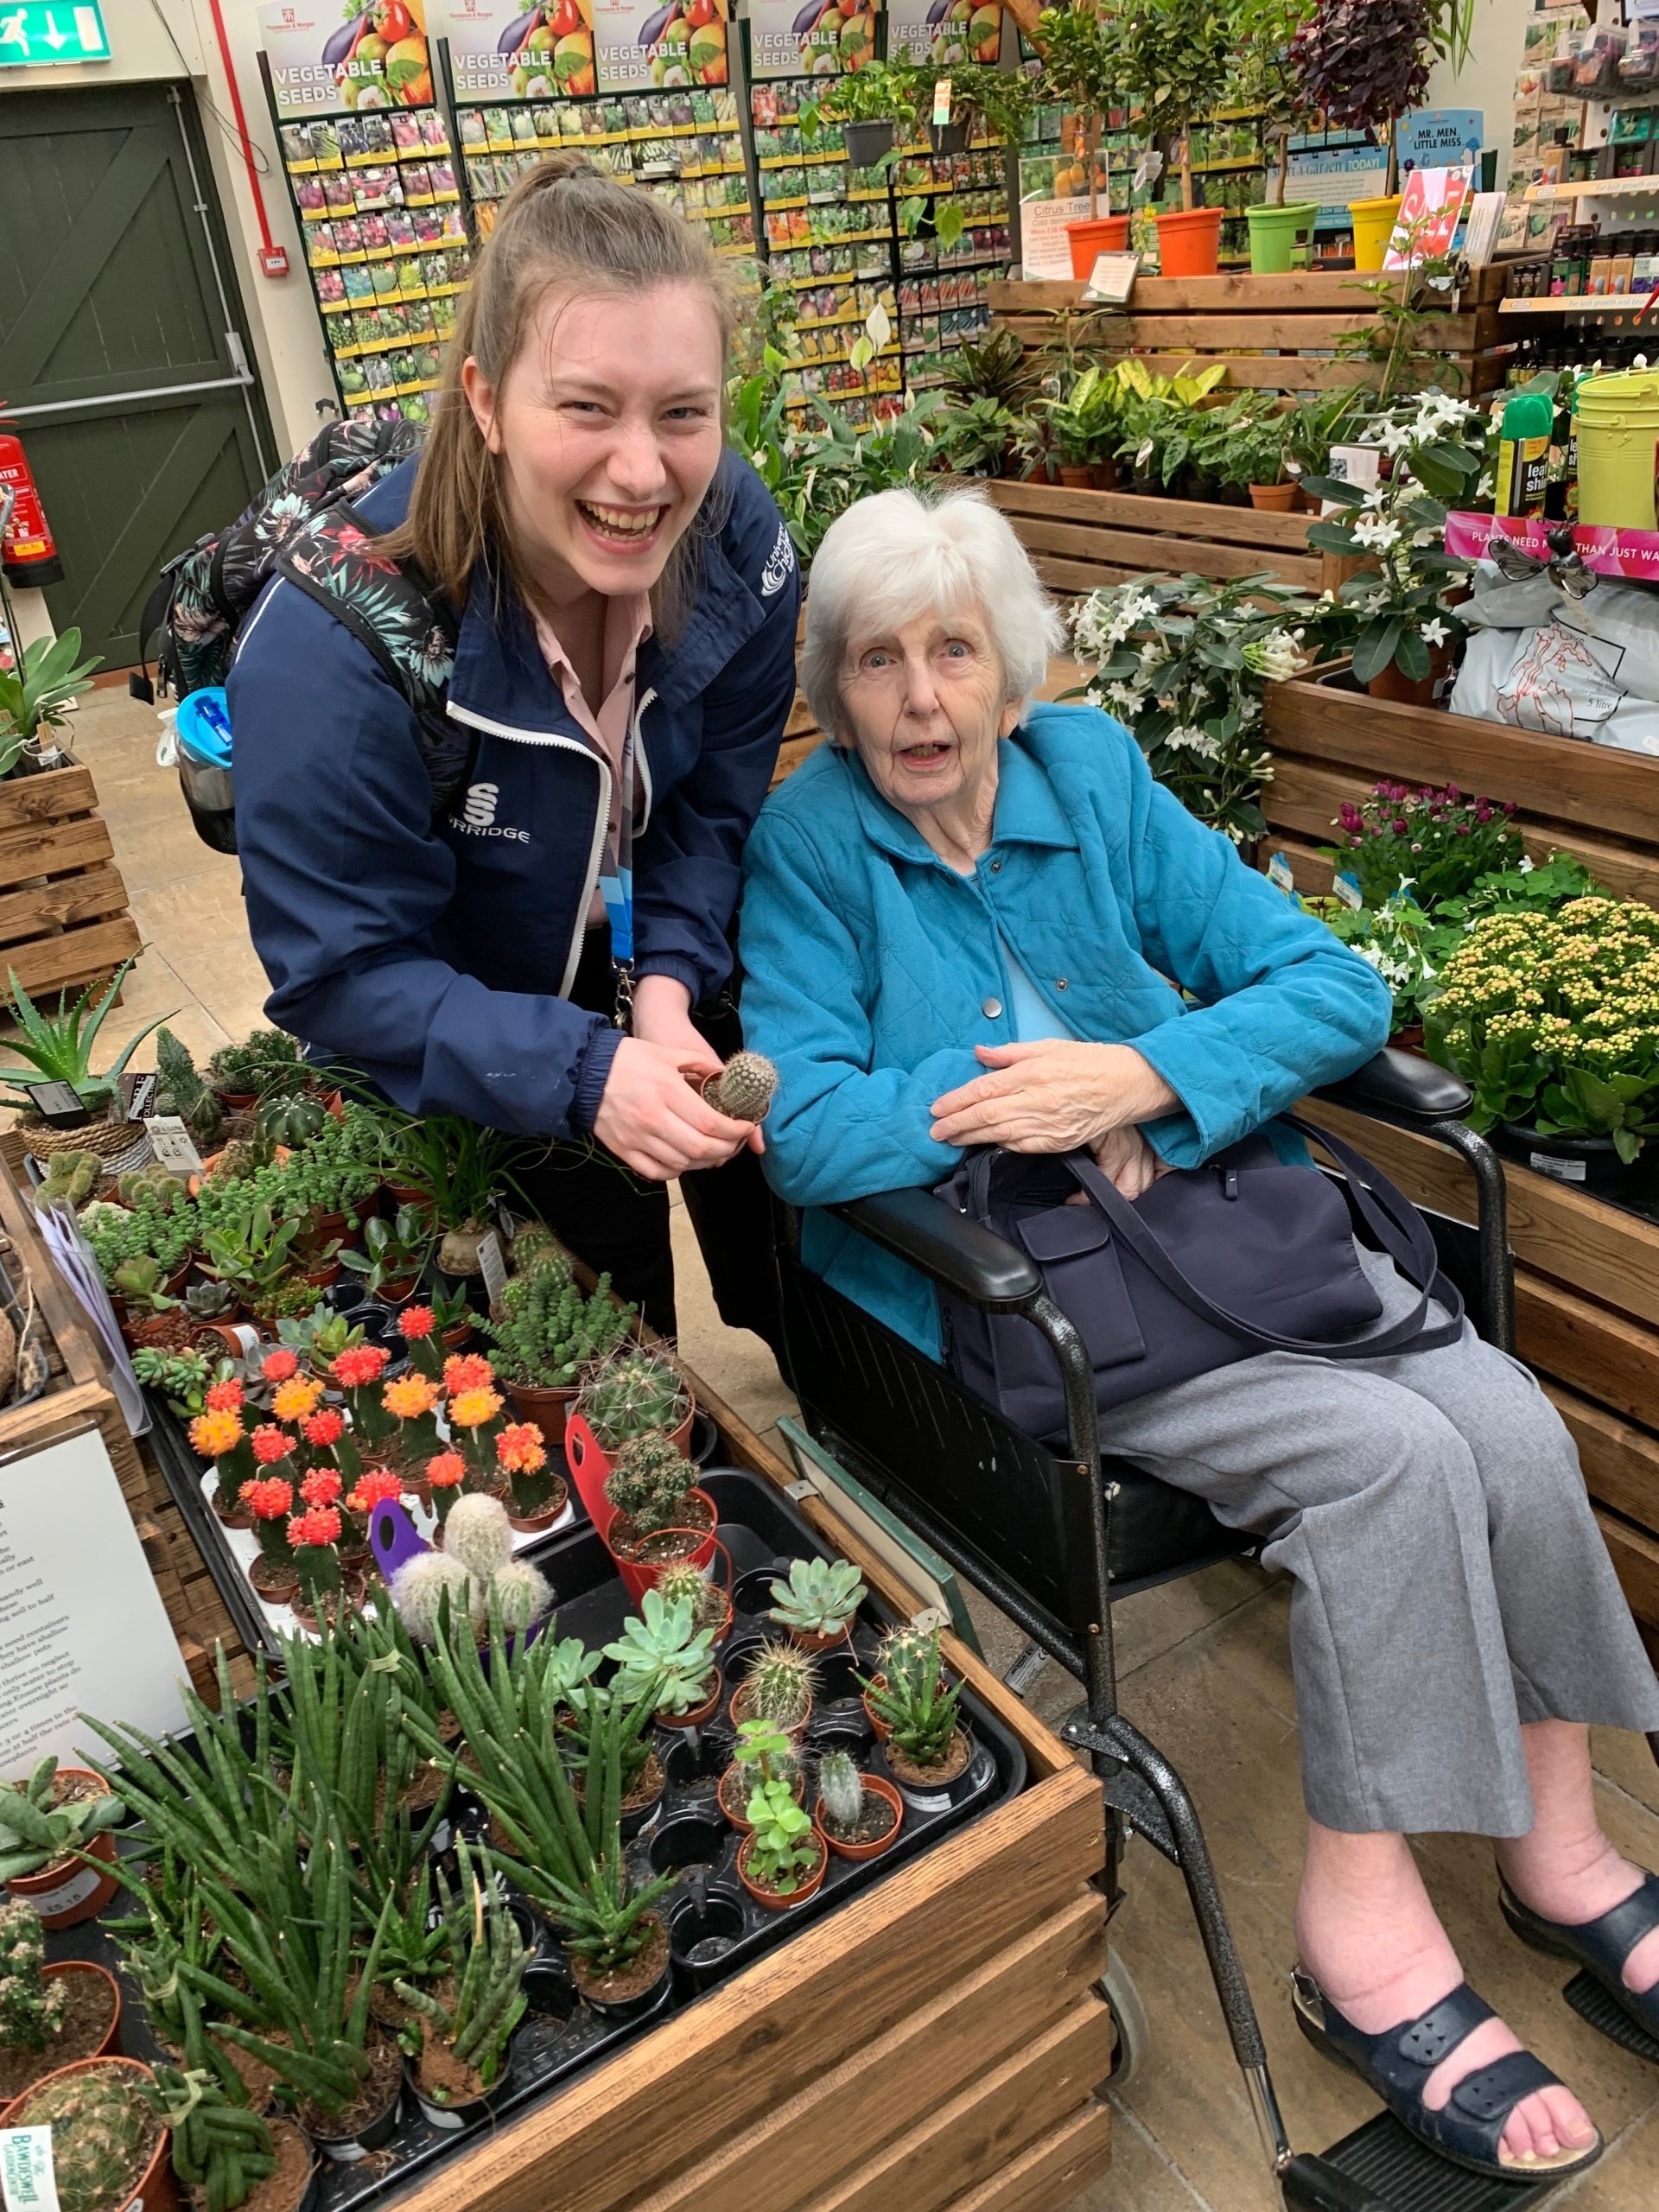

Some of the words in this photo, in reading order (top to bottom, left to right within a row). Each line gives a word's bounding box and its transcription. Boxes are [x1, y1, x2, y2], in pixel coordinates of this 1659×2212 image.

[753, 30, 838, 49] VEGETABLE
[891, 21, 967, 39] VEGETABLE
[454, 49, 551, 71] VEGETABLE
[599, 41, 688, 62] VEGETABLE
[753, 50, 799, 67] SEEDS
[273, 59, 383, 85] VEGETABLE
[455, 72, 509, 92] SEEDS
[600, 63, 648, 83] SEEDS
[278, 86, 338, 106] SEEDS
[1414, 140, 1438, 150] LITTLE
[1440, 137, 1462, 148] MISS
[1418, 130, 1434, 140] MR.
[1437, 128, 1457, 138] MEN
[1348, 157, 1380, 171] TODAY!
[1034, 206, 1064, 216] Citrus
[1067, 202, 1090, 212] Tree
[1032, 219, 1047, 227] Cold
[0, 469, 19, 480] ATER
[1526, 476, 1548, 492] shin
[1472, 531, 1510, 543] PLANTS
[1513, 537, 1539, 549] NEED
[1575, 543, 1605, 556] THAN
[1609, 546, 1637, 559] JUST
[1587, 698, 1593, 707] 5
[1595, 698, 1612, 709] litre
[448, 814, 531, 843] RRIDGE
[17, 1556, 35, 1567] east
[26, 1578, 43, 1590] well
[11, 1606, 26, 1618] soil
[37, 1592, 54, 1605] half
[4, 1634, 25, 1648] need
[27, 1615, 69, 1637] containers
[0, 1650, 14, 1660] hey
[16, 1640, 36, 1652] have
[37, 1626, 68, 1643] shallow
[1, 1653, 31, 1670] shallow
[34, 1643, 52, 1656] pots
[3, 1672, 27, 1686] thrive
[29, 1666, 40, 1675] on
[41, 1651, 70, 1668] neglect
[3, 1685, 20, 1697] only
[22, 1673, 45, 1688] water
[57, 1659, 74, 1671] stop
[44, 1672, 69, 1688] plants
[70, 1666, 81, 1675] do
[0, 1707, 16, 1719] ater
[18, 1687, 57, 1710] overnight
[5, 1737, 10, 1745] 3
[11, 1732, 21, 1741] or
[30, 1717, 54, 1731] times
[54, 1711, 63, 1720] in
[64, 1705, 78, 1715] the
[22, 1733, 39, 1746] half
[40, 1727, 53, 1738] the
[54, 1719, 70, 1730] rate
[11, 2134, 39, 2203] BAWDESWELL
